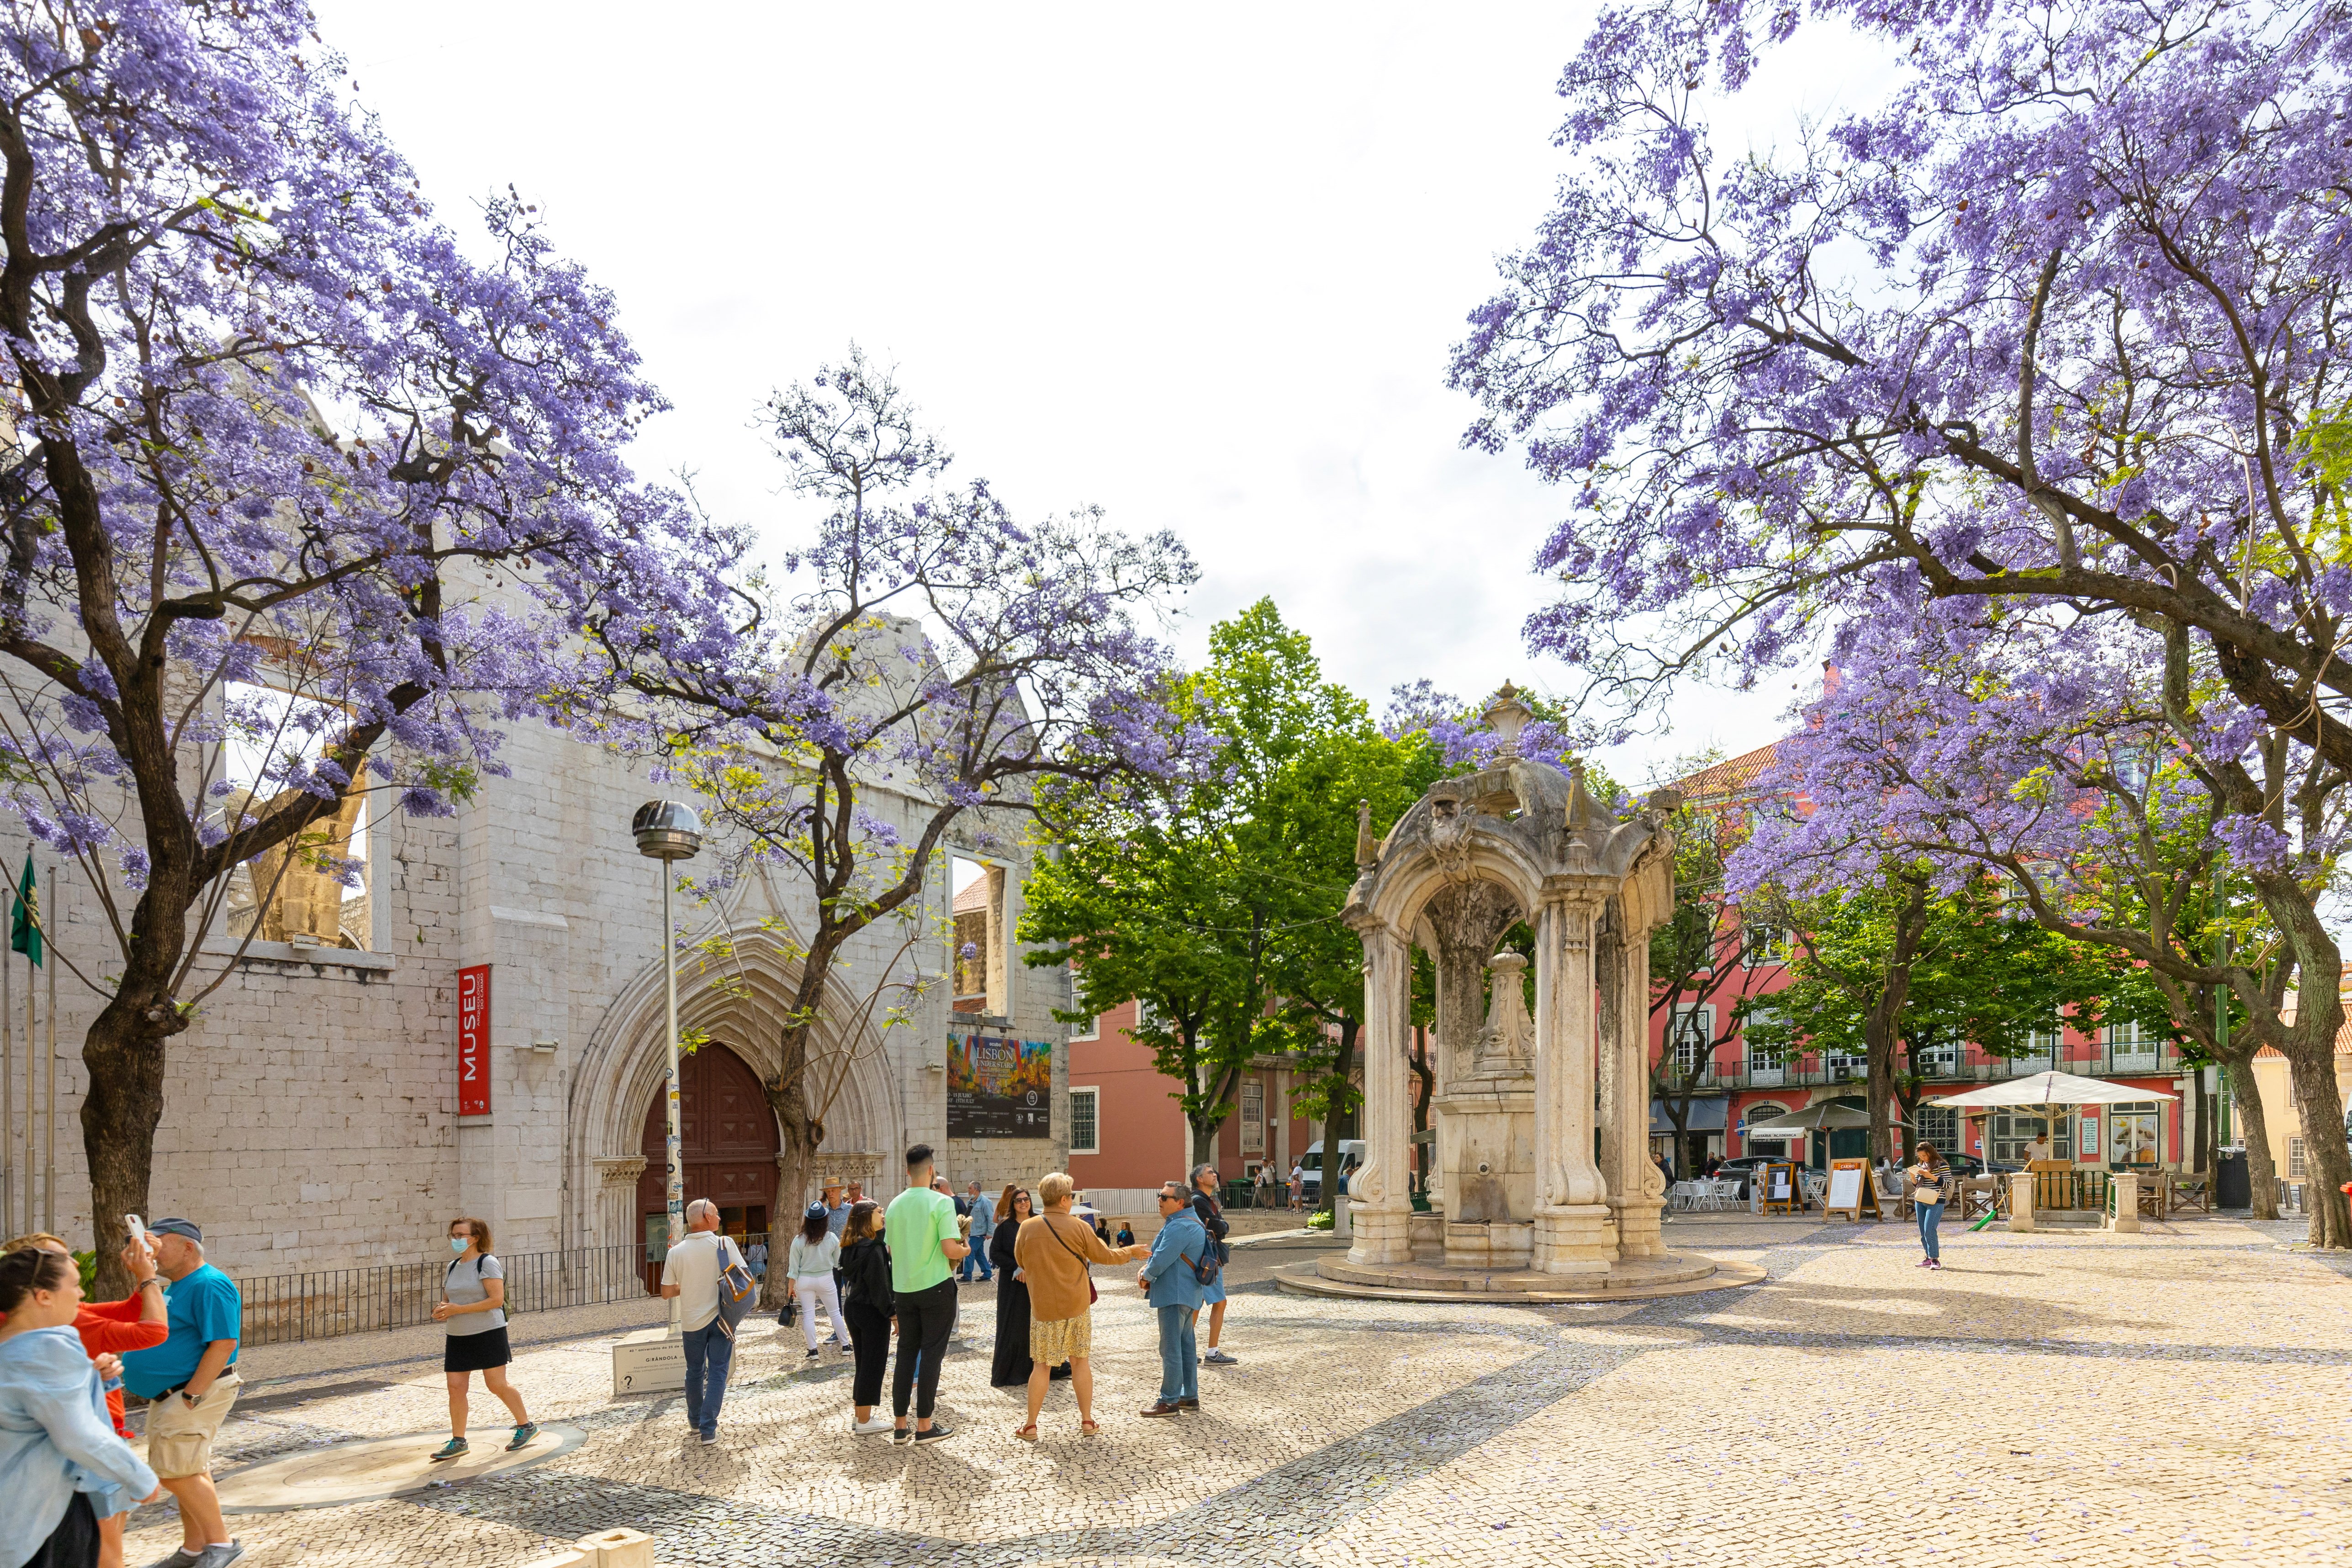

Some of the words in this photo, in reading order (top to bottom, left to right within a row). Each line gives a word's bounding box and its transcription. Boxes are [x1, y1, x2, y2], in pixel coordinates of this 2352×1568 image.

[480, 999, 484, 1009] DO
[464, 975, 476, 1081] MUSEU
[976, 1047, 1014, 1061] LISBON
